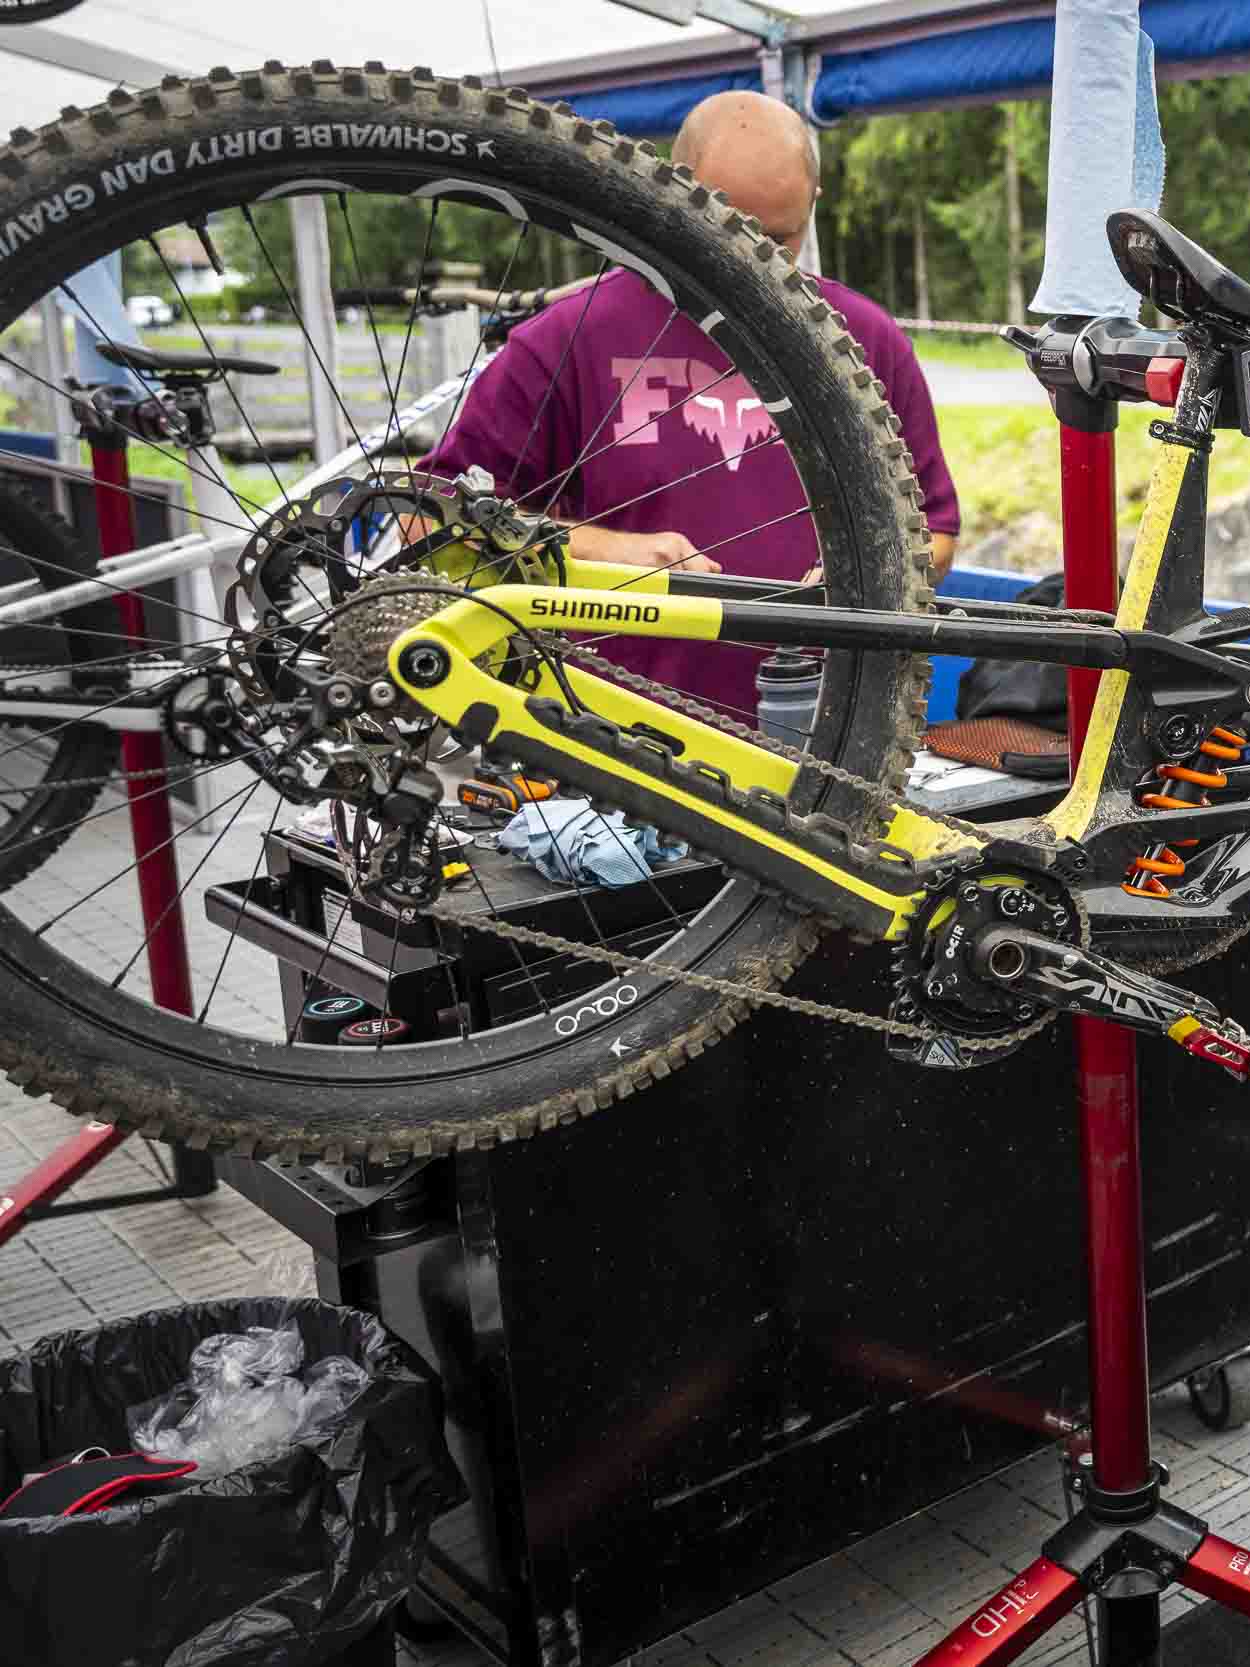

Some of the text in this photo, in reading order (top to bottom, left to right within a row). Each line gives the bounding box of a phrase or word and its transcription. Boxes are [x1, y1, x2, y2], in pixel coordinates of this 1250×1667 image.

[0, 122, 467, 261] SCHWALBE DIRTY DAN GRAVI
[530, 598, 660, 623] SHIMANO
